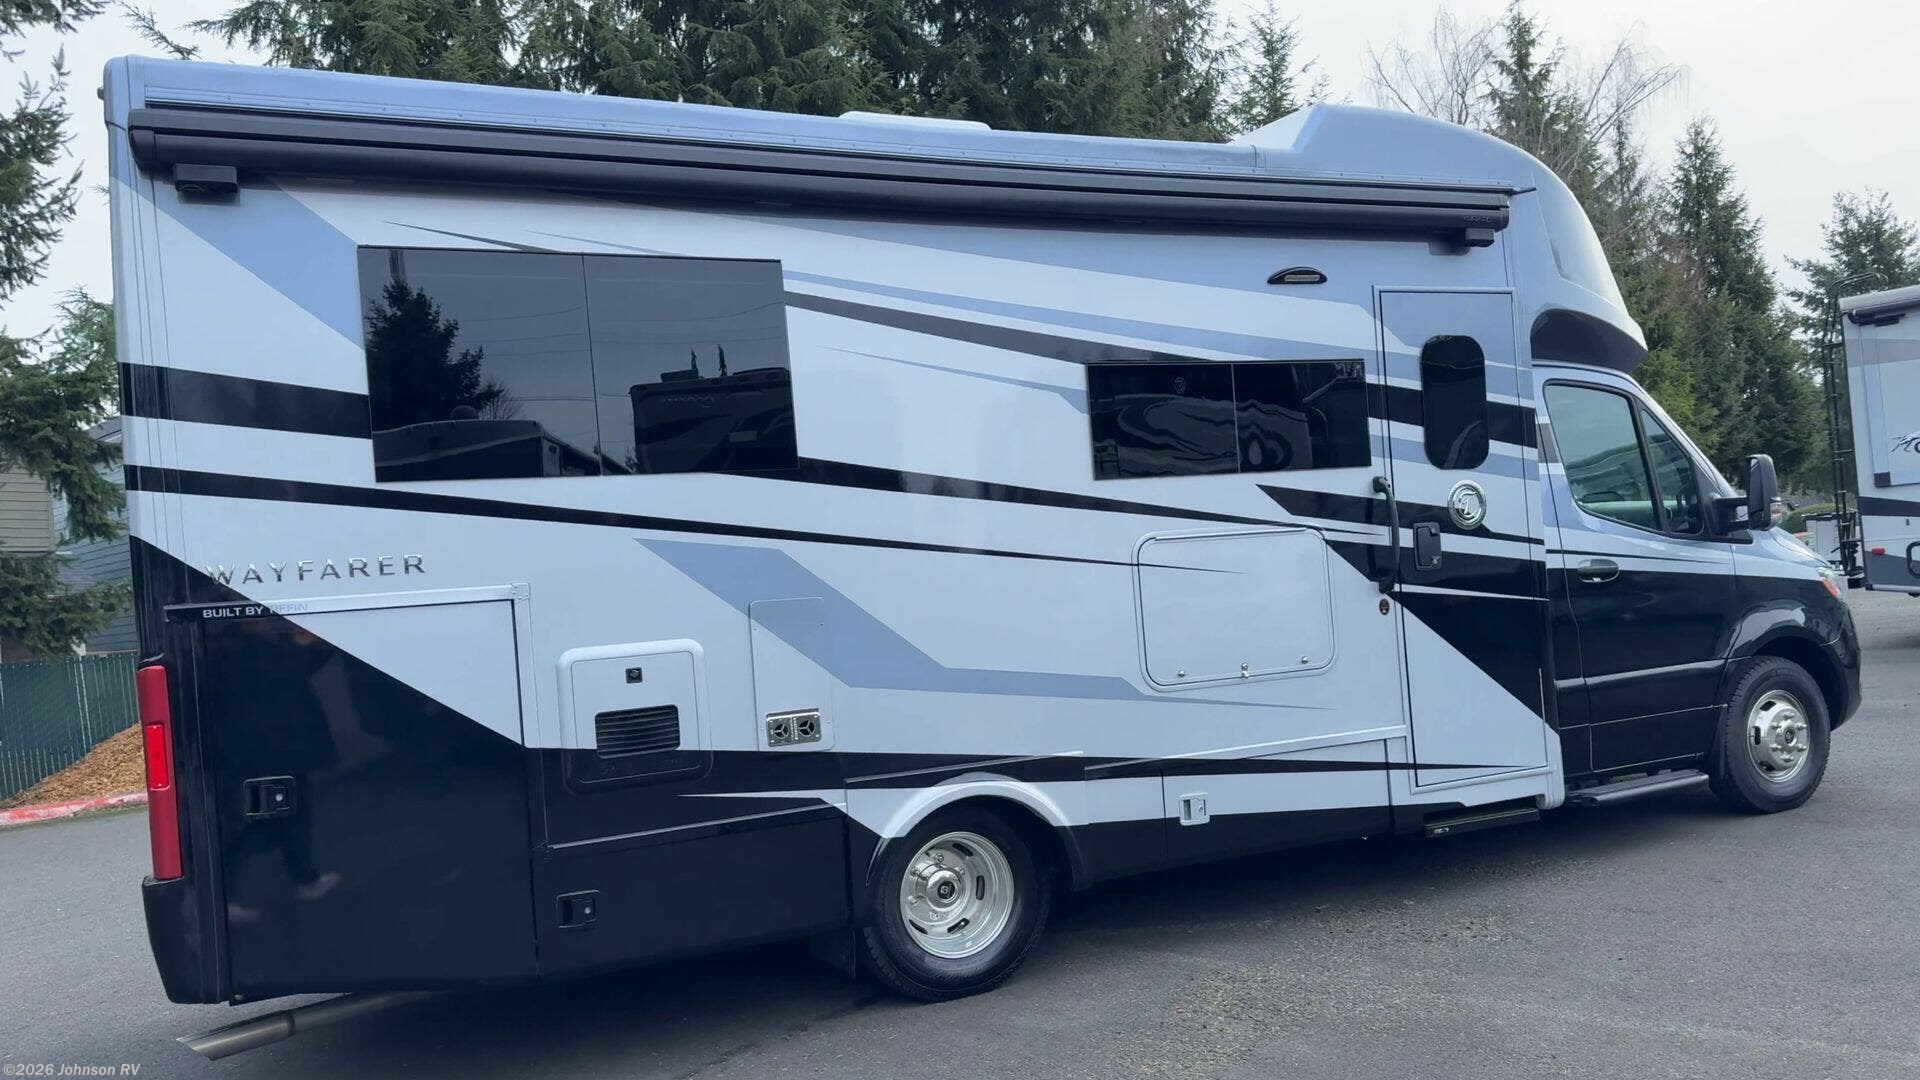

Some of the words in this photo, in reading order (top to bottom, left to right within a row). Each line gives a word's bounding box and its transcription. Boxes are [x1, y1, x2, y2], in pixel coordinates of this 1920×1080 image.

[205, 554, 426, 585] WAYFARER
[202, 607, 242, 619] BUILT
[245, 605, 264, 616] BY
